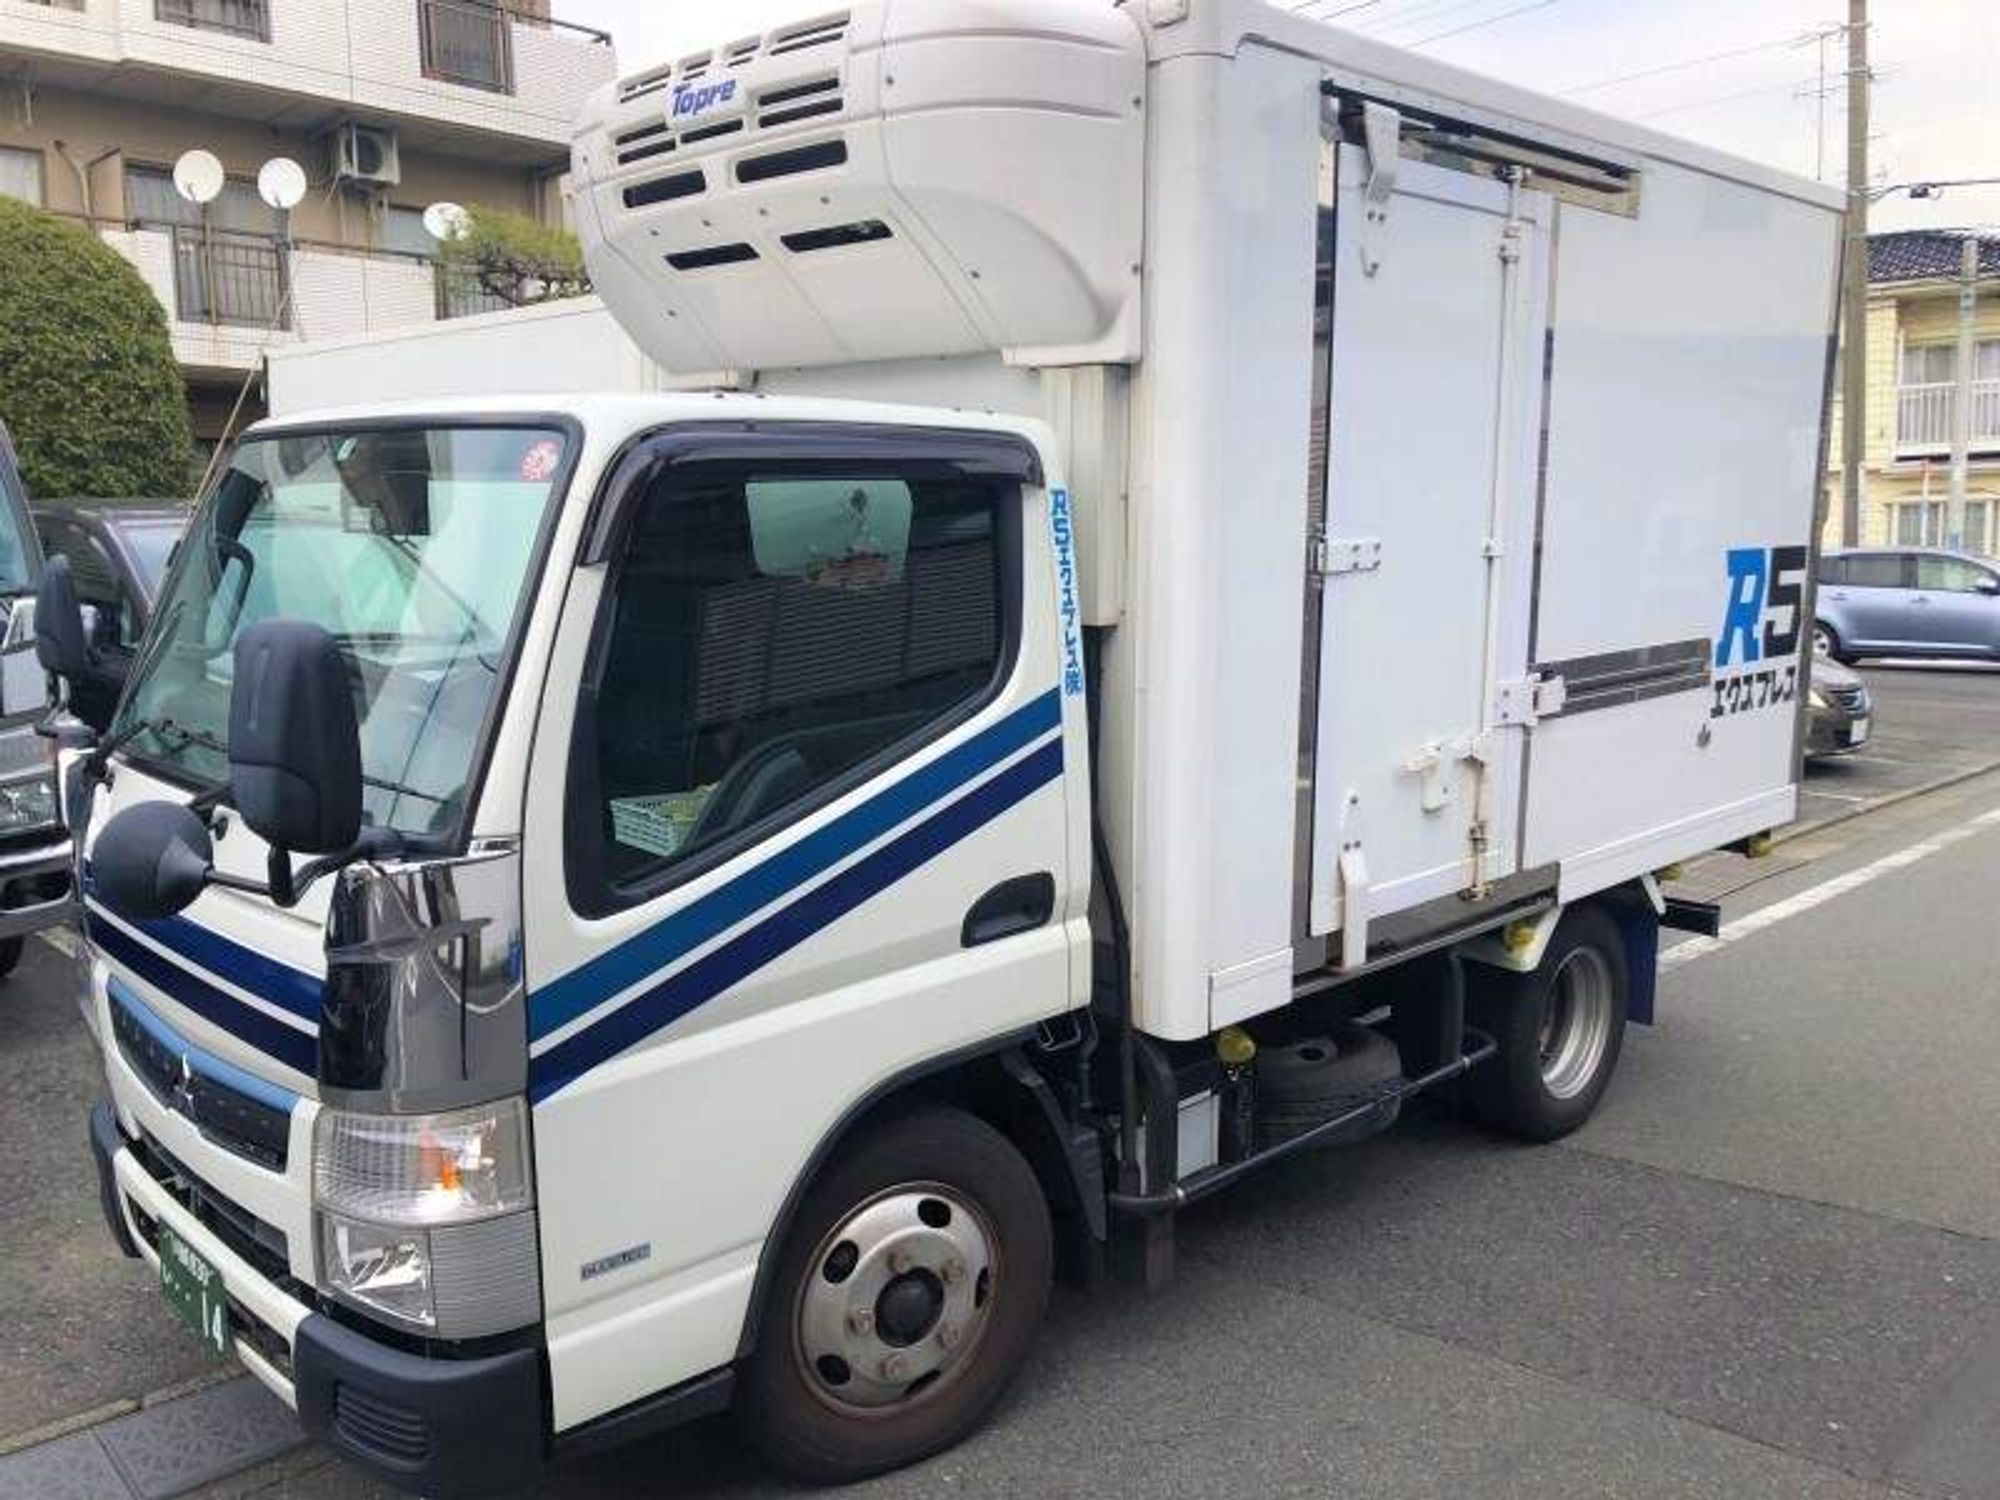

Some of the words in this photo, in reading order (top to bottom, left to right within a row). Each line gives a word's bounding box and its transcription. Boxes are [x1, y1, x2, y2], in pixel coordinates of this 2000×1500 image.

[673, 80, 736, 117] Topre
[1715, 546, 1807, 668] R5
[1710, 666, 1796, 718] エクスプレス
